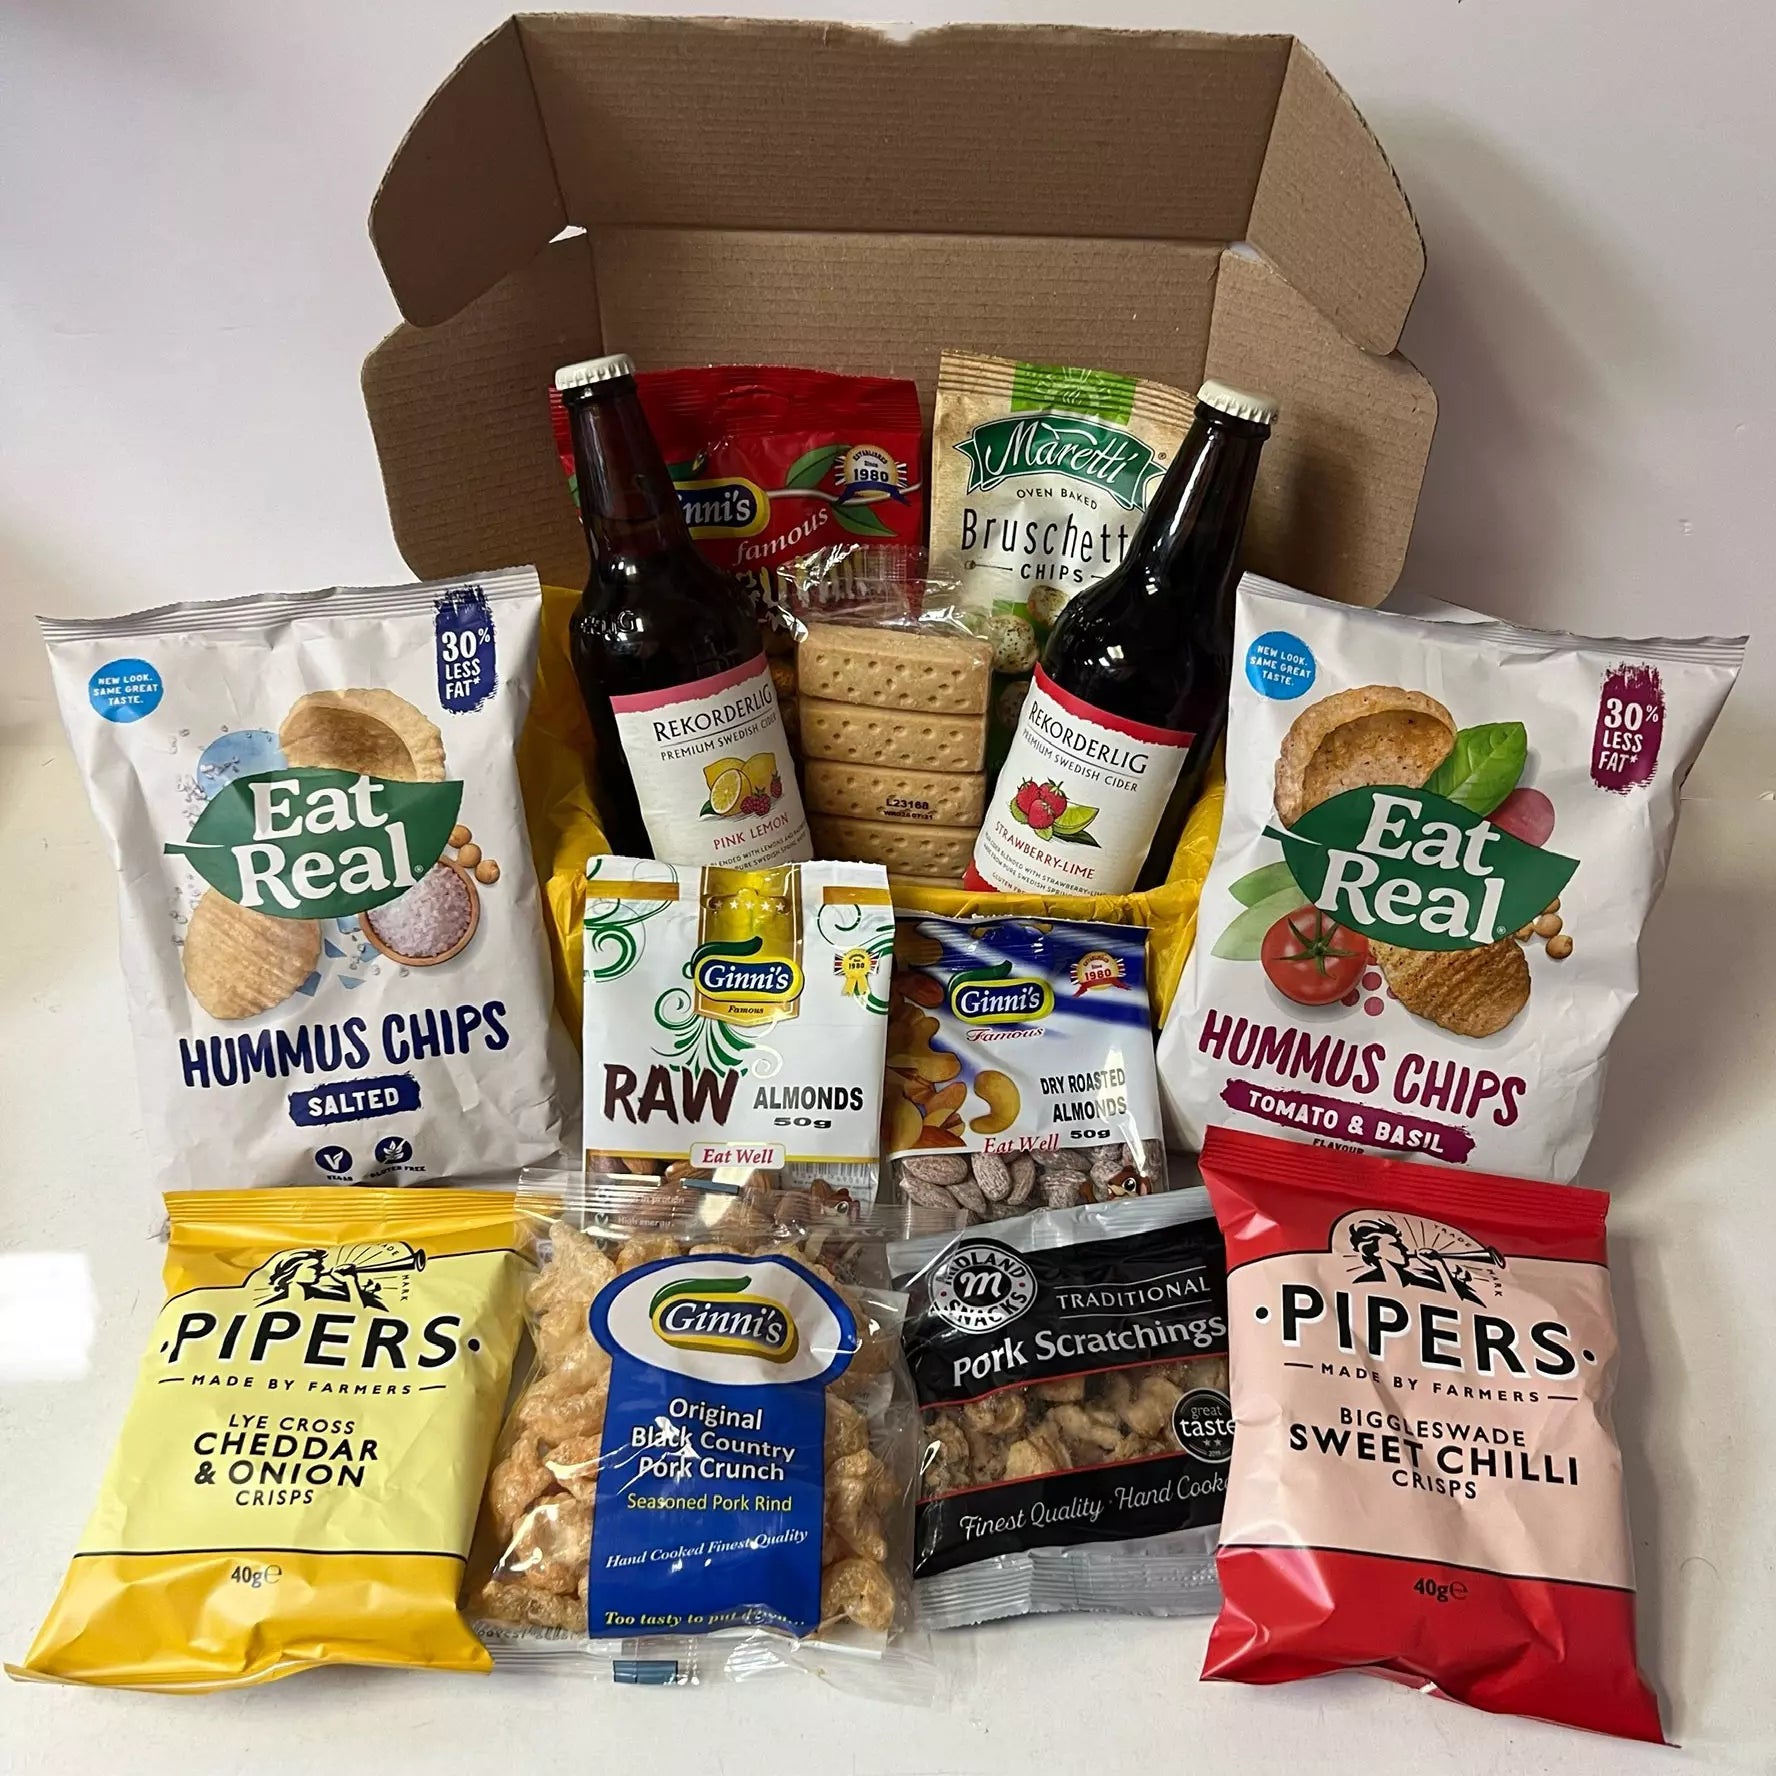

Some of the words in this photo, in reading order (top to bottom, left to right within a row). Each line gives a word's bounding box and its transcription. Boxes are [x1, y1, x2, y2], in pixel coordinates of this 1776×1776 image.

[985, 421, 1139, 484] Maretti
[854, 469, 889, 481] 1980
[678, 489, 751, 525] nni's
[1016, 487, 1053, 499] OVEN
[1060, 487, 1098, 510] BAKED
[732, 508, 829, 566] famous
[961, 508, 1129, 564] Bruschett
[1020, 563, 1083, 583] CHIPS
[441, 627, 491, 662] 30%
[1257, 645, 1278, 657] NEW
[1280, 651, 1308, 666] LOOK.
[98, 677, 120, 685] NEW
[123, 674, 153, 684] LOOK.
[445, 658, 481, 680] LESS
[1250, 656, 1278, 669] SAME
[1280, 663, 1312, 679] GREAT
[1262, 670, 1294, 686] TASTE.
[93, 687, 122, 696] SAME
[125, 684, 158, 693] GREAT
[108, 695, 144, 706] TASTE.
[653, 683, 773, 741] REKORDERLIG
[1604, 698, 1659, 731] 30%
[661, 740, 715, 761] PREMIUM
[717, 723, 759, 747] SWEDISH
[1028, 700, 1149, 774] REKORDERLIG
[1603, 730, 1643, 753] LESS
[1054, 754, 1100, 781] SWEDISH
[1104, 775, 1138, 792] CIDER
[247, 775, 390, 841] Eat
[713, 831, 746, 850] PINK
[750, 812, 789, 839] LEMON
[1356, 792, 1501, 876] Eat
[743, 847, 760, 859] WITH
[995, 821, 1096, 880] STRAWBERRY-LIME
[231, 821, 416, 910] Real
[1024, 866, 1041, 878] WITH
[1018, 872, 1046, 890] SWEDISH
[1314, 849, 1506, 944] Real
[703, 964, 791, 990] Ginni's
[1085, 968, 1112, 980] 1980
[727, 1005, 764, 1015] Famous
[960, 986, 1040, 1014] Ginni's
[178, 1016, 371, 1089] HUMMUS
[382, 1000, 510, 1065] CHIPS
[966, 1027, 1045, 1042] Famous
[1040, 1075, 1065, 1095] DRY
[1068, 1068, 1126, 1093] ROASTED
[1199, 1009, 1386, 1094] HUMMUS
[1393, 1053, 1526, 1127] CHIPS
[308, 1087, 400, 1118] SALTED
[603, 1063, 740, 1127] RAW
[753, 1086, 864, 1111] ALMONDS
[1052, 1096, 1127, 1123] ALMONDS
[773, 1116, 832, 1129] 50g
[1070, 1129, 1111, 1139] 50g
[1249, 1090, 1339, 1130] TOMATO
[1347, 1115, 1364, 1136] &
[1374, 1120, 1444, 1153] BASIL
[702, 1148, 733, 1164] Eat
[736, 1148, 774, 1165] Well
[983, 1137, 1015, 1155] Eat
[1018, 1134, 1060, 1153] Well
[1312, 1138, 1365, 1155] FLAVOUR
[1056, 1276, 1211, 1310] TRADITIONAL
[665, 1302, 783, 1343] Ginni's
[949, 1292, 1028, 1327] SNACKS
[168, 1311, 462, 1370] PIPERS
[1280, 1284, 1577, 1378] PIPERS
[953, 1337, 1028, 1387] Pork
[1035, 1316, 1227, 1361] Scratchings
[191, 1374, 255, 1388] MADE
[268, 1378, 295, 1391] BY
[308, 1381, 412, 1395] FARMERS
[1321, 1362, 1381, 1384] MADE
[1393, 1376, 1418, 1391] BY
[1432, 1382, 1540, 1403] FARMERS
[228, 1414, 268, 1429] LYE
[279, 1417, 355, 1434] CROSS
[669, 1397, 763, 1430] Original
[1179, 1418, 1235, 1437] taste
[1190, 1406, 1223, 1420] great
[1340, 1407, 1526, 1447] BIGGLESWADE
[193, 1432, 379, 1461] CHEDDAR
[631, 1425, 692, 1448] Black
[700, 1431, 796, 1463] Country
[1289, 1423, 1423, 1468] SWEET
[1436, 1446, 1579, 1486] CHILLI
[194, 1460, 216, 1485] &
[228, 1460, 365, 1488] ONION
[638, 1456, 693, 1479] Pork
[699, 1457, 785, 1481] Crunch
[235, 1489, 314, 1506] CRISPS
[1392, 1469, 1477, 1499] CRISPS
[627, 1493, 707, 1510] Seasoned
[712, 1495, 749, 1511] Pork
[755, 1495, 792, 1512] Rind
[959, 1508, 1027, 1541] Finest
[1030, 1498, 1105, 1528] Quality
[1114, 1480, 1174, 1511] Hand
[1177, 1471, 1228, 1500] Cook
[605, 1551, 647, 1568] Hand
[650, 1543, 705, 1561] Cooked
[707, 1539, 751, 1554] Finest
[755, 1528, 808, 1549] Quality
[605, 1611, 635, 1625] Too
[640, 1613, 682, 1628] tasty
[687, 1612, 704, 1624] to
[707, 1612, 736, 1626] put
